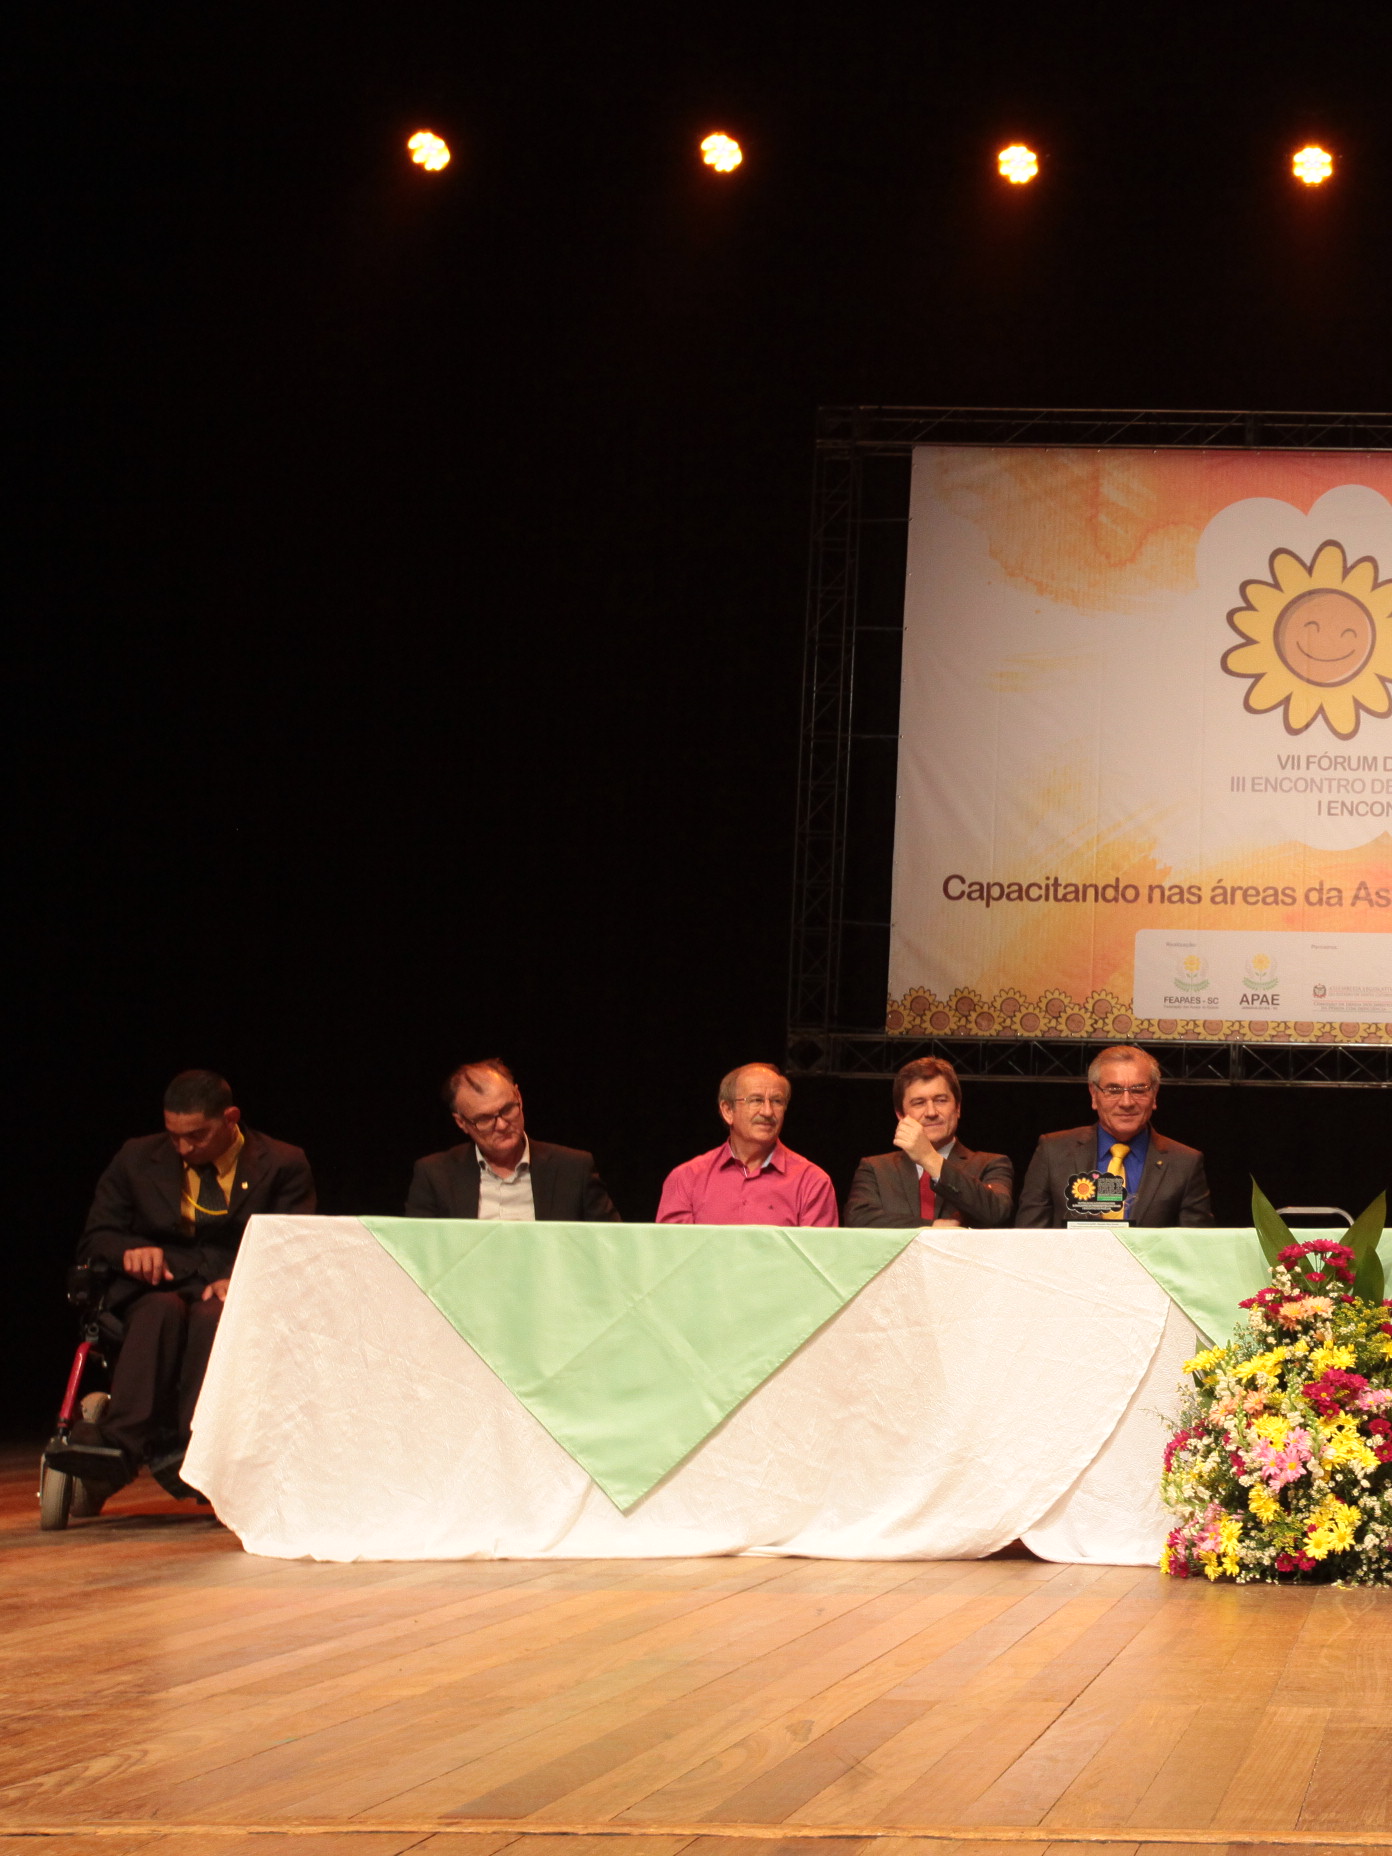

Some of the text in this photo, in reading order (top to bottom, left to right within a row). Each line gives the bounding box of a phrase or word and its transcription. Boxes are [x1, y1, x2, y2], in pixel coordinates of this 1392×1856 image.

[1277, 754, 1301, 771] VII
[1305, 751, 1378, 772] FÓRUM
[1230, 776, 1246, 793] III
[1251, 776, 1366, 794] ENCONTRO
[1317, 800, 1322, 816] I
[942, 874, 1140, 908] Capacitando
[1148, 883, 1203, 905] nas
[1209, 878, 1297, 907] áreas
[1304, 880, 1344, 908] da
[1164, 996, 1201, 1005] FEAPAES
[1207, 997, 1219, 1005] SC
[1239, 993, 1280, 1006] APAE
